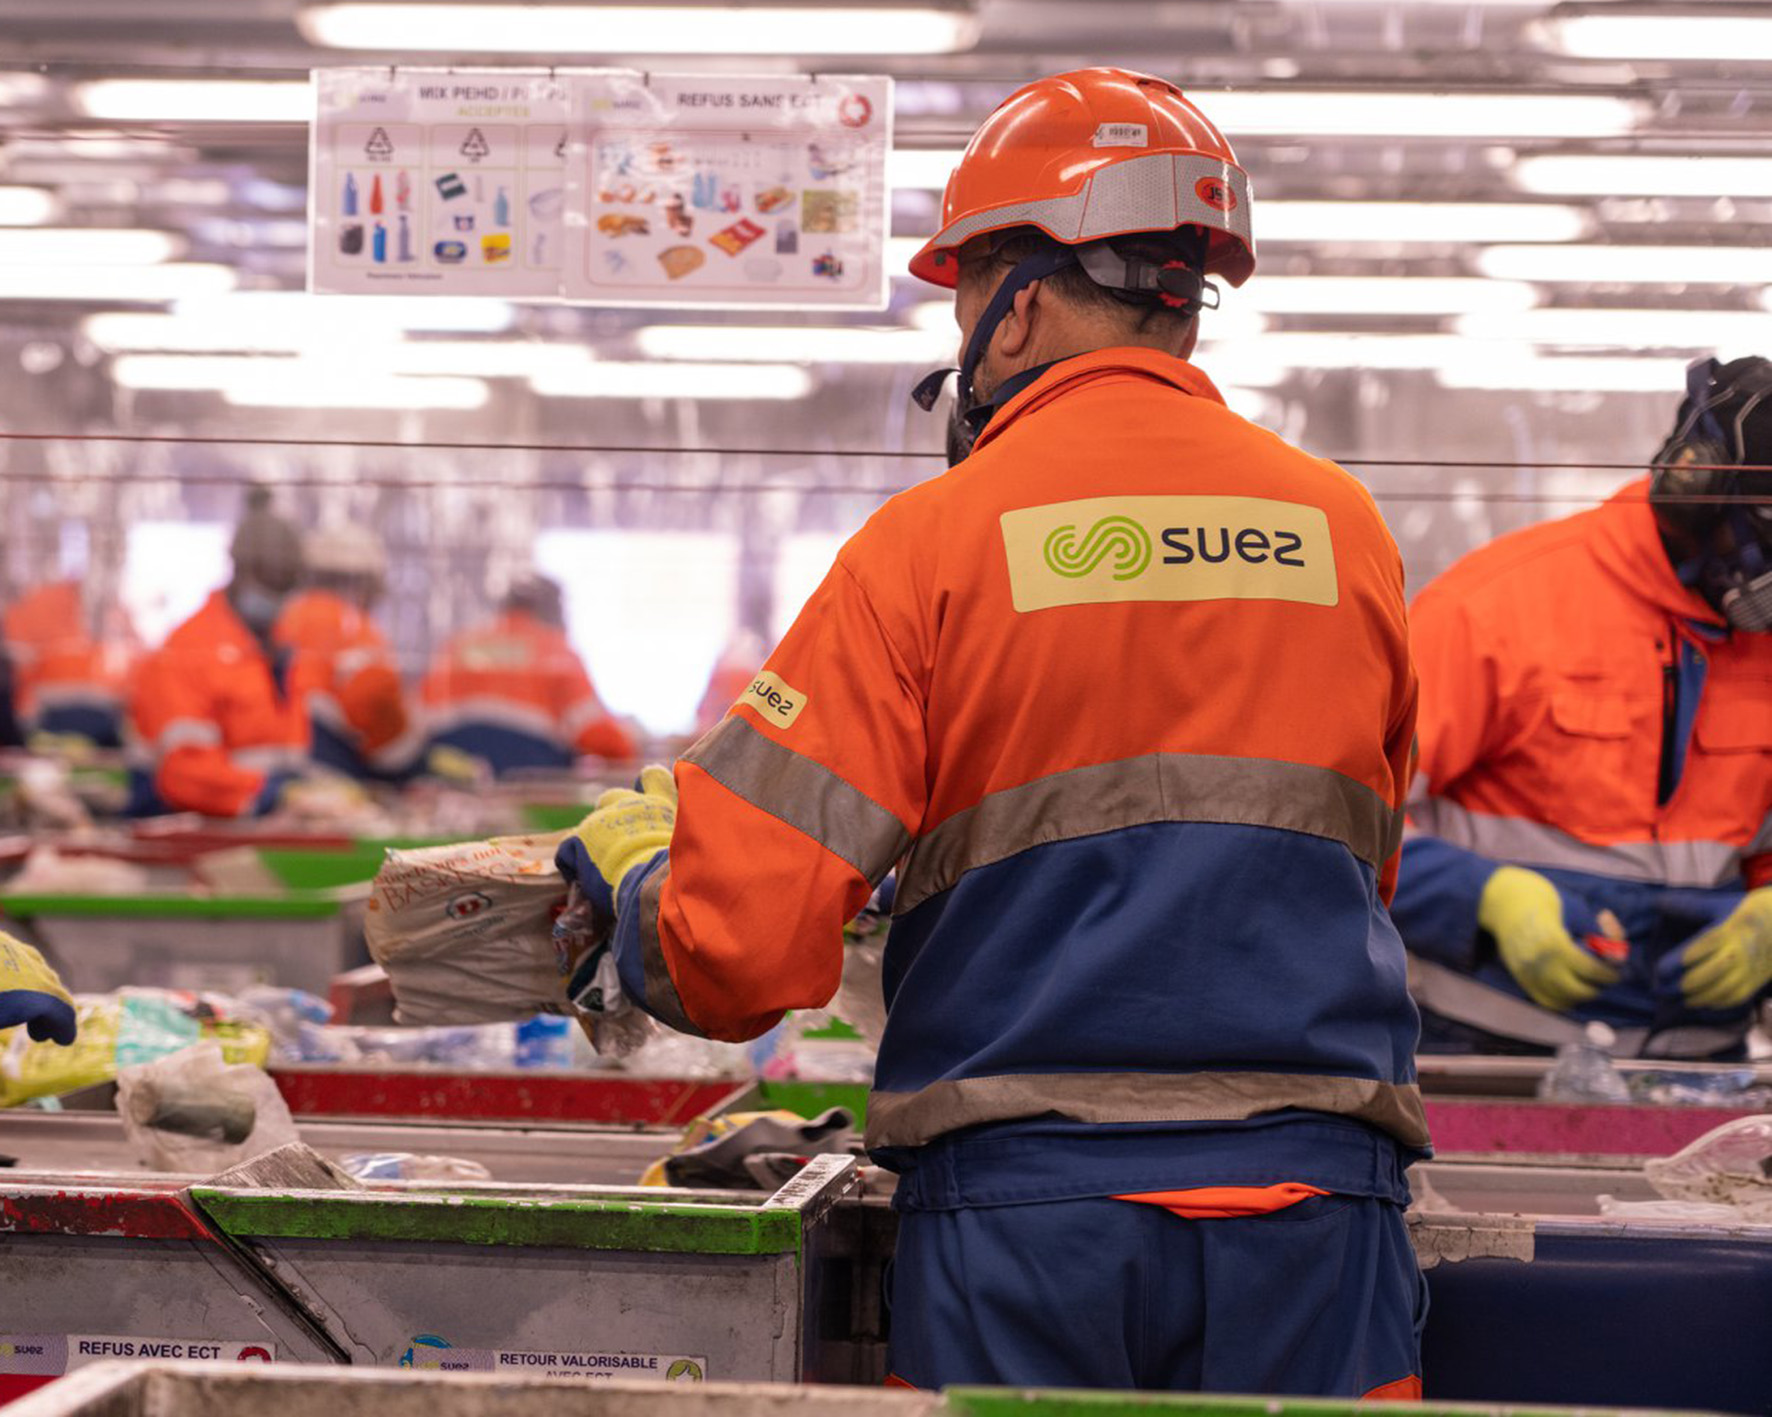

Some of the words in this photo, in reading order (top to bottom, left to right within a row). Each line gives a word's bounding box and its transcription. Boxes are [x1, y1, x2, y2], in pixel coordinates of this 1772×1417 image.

[676, 93, 734, 108] REFUS
[1161, 527, 1305, 567] suez
[79, 1341, 135, 1357] REFUS
[138, 1343, 183, 1359] AVEC
[187, 1346, 221, 1361] ECT
[500, 1353, 557, 1367] RETOUR
[561, 1354, 659, 1370] VALORISABLE
